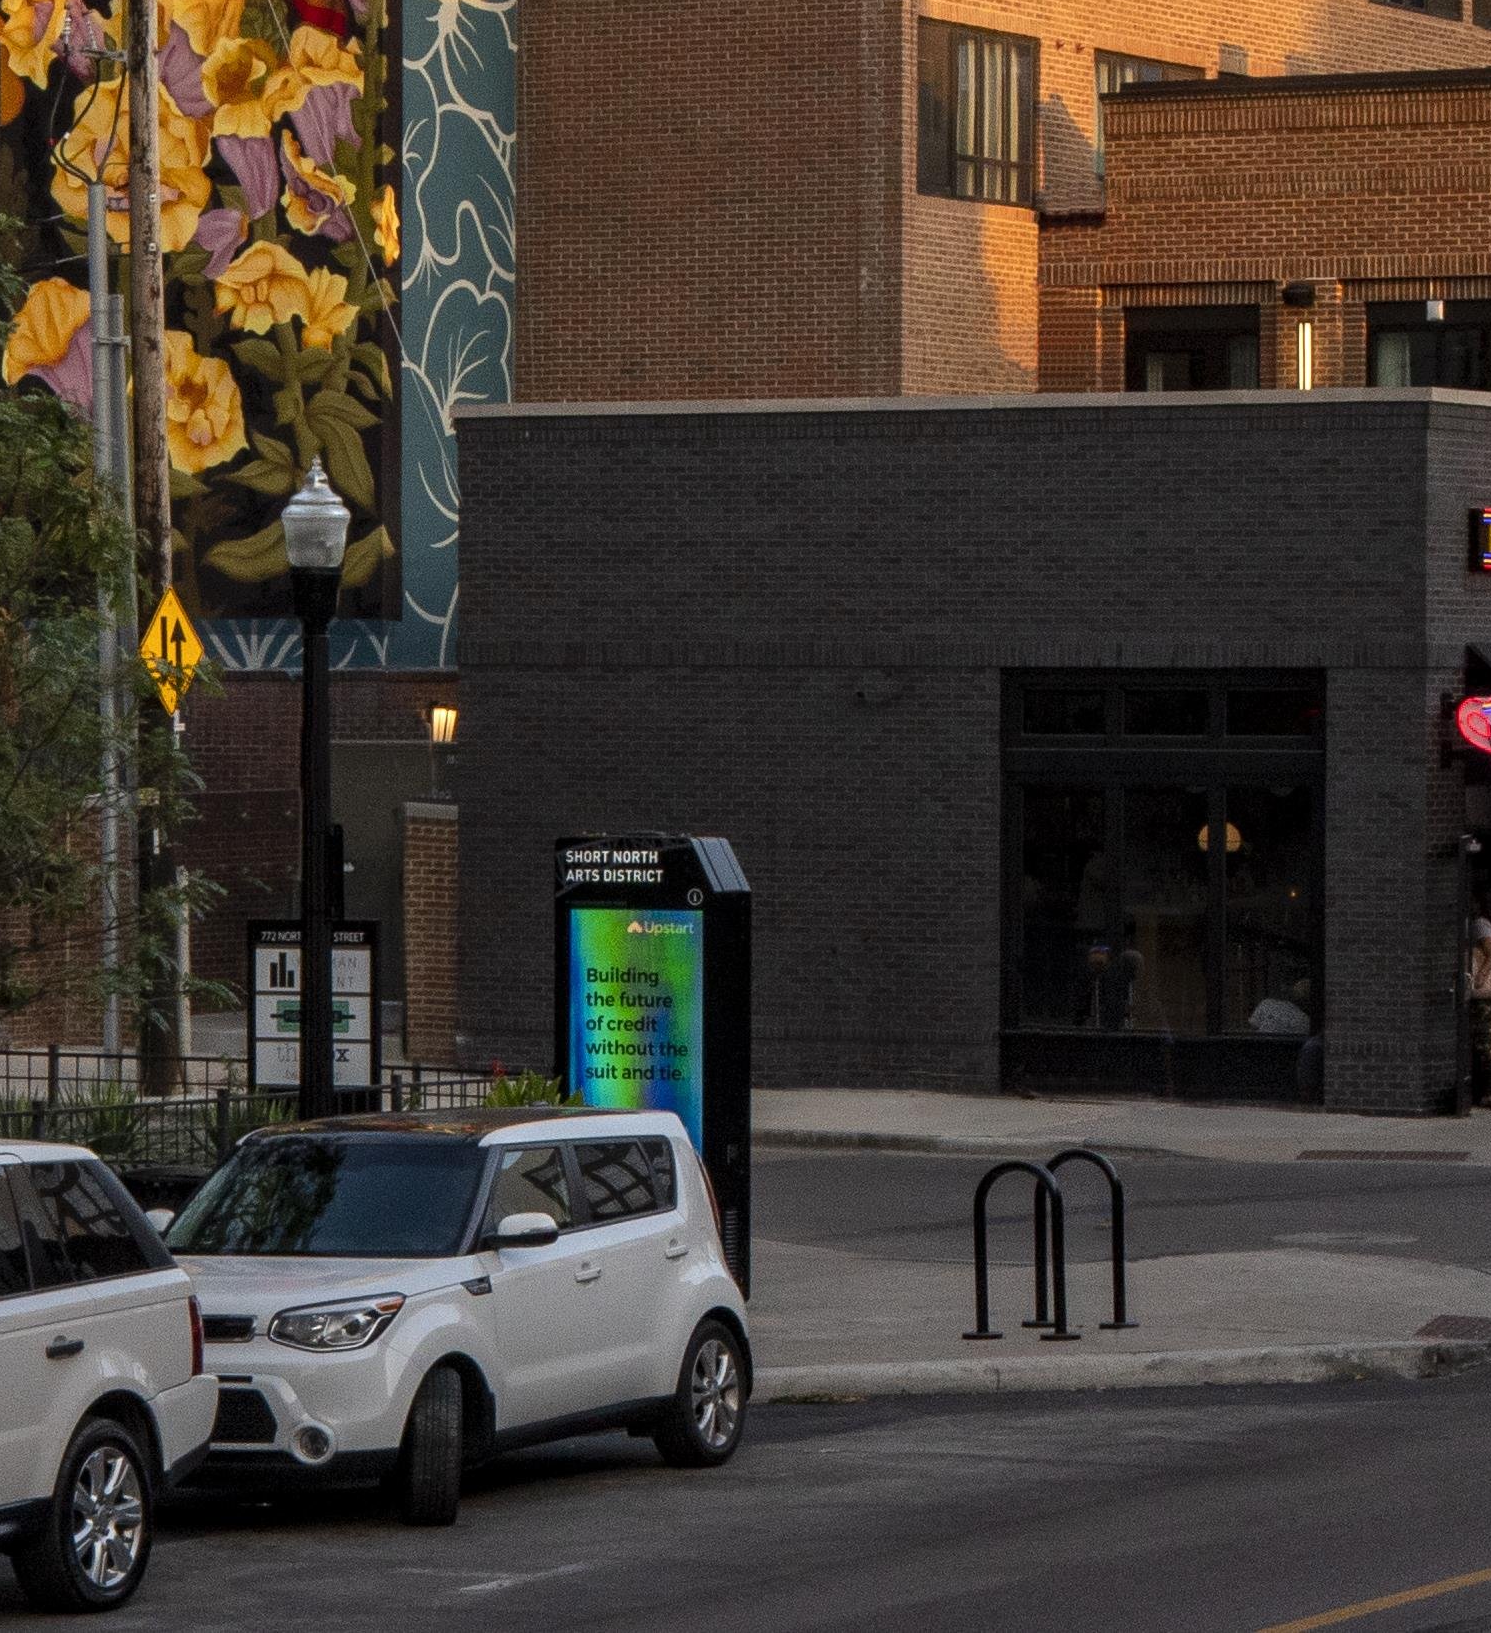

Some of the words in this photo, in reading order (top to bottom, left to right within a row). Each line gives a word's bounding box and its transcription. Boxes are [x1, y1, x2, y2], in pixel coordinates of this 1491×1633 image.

[565, 850, 609, 864] SHORT
[613, 850, 659, 864] NORTH
[565, 869, 600, 882] ARTS
[603, 869, 664, 883] DISTRICT
[644, 920, 695, 936] Upstart
[261, 932, 276, 941] 772
[278, 932, 301, 942] NORT
[333, 932, 365, 942] STREET
[586, 967, 660, 987] Building
[586, 991, 615, 1007] the
[620, 991, 673, 1008] future
[585, 1015, 604, 1031] of
[607, 1015, 658, 1031] credit
[585, 1038, 654, 1056] without
[659, 1038, 689, 1057] the
[585, 1063, 618, 1079] suit
[621, 1065, 654, 1081] and
[659, 1065, 685, 1081] tie.
